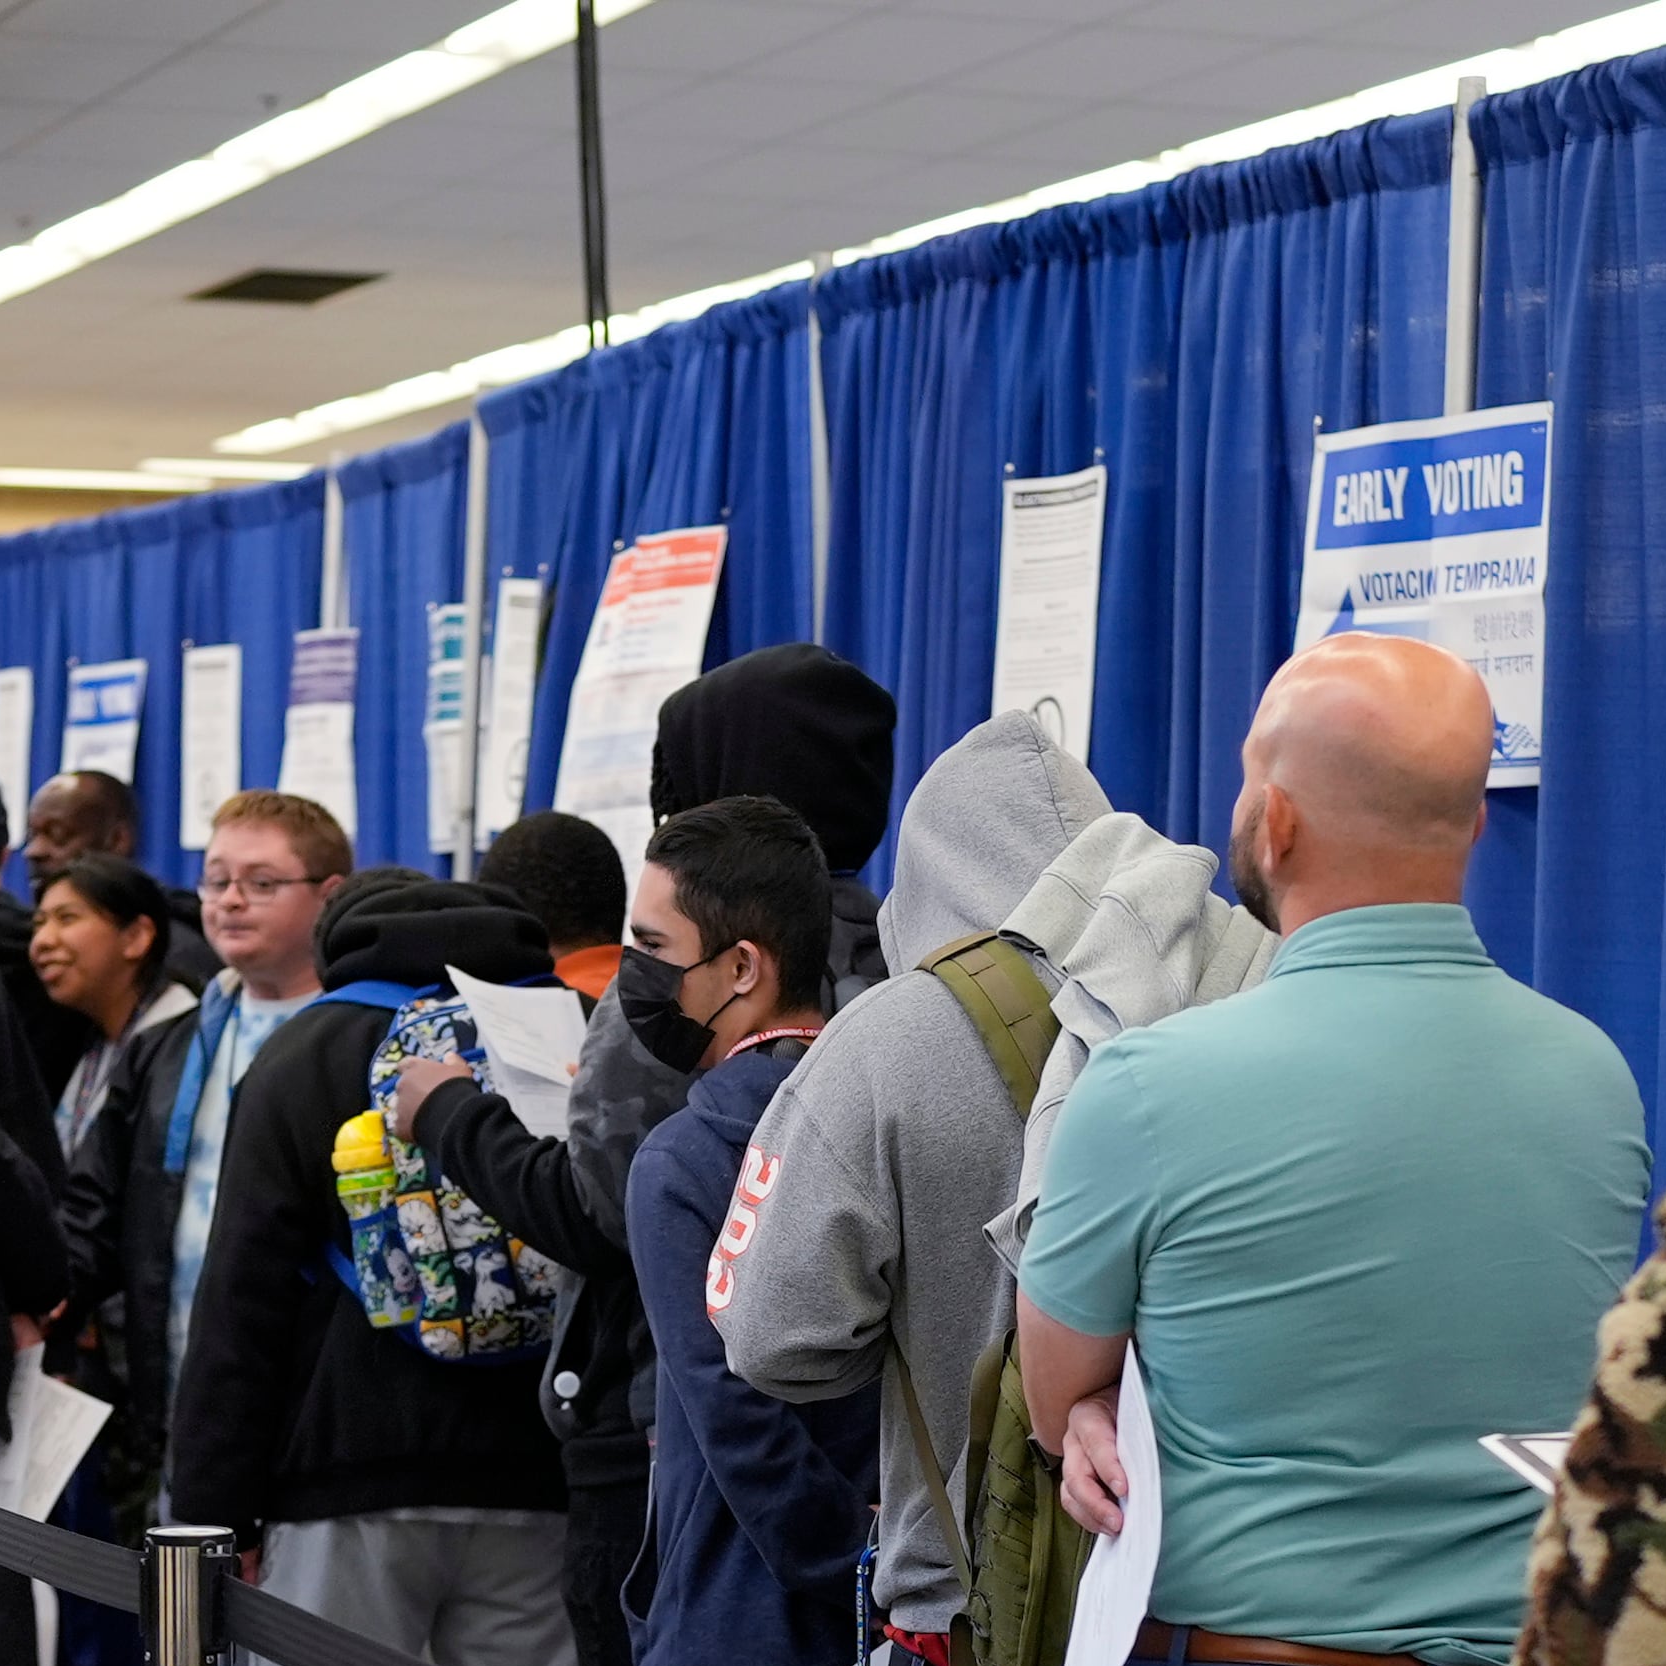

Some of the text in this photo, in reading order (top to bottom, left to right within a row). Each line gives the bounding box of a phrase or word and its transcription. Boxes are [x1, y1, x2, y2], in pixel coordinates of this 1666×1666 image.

[1333, 450, 1525, 527] EARLY VOTING
[1359, 556, 1536, 602] VOTACIN TEMPRANA
